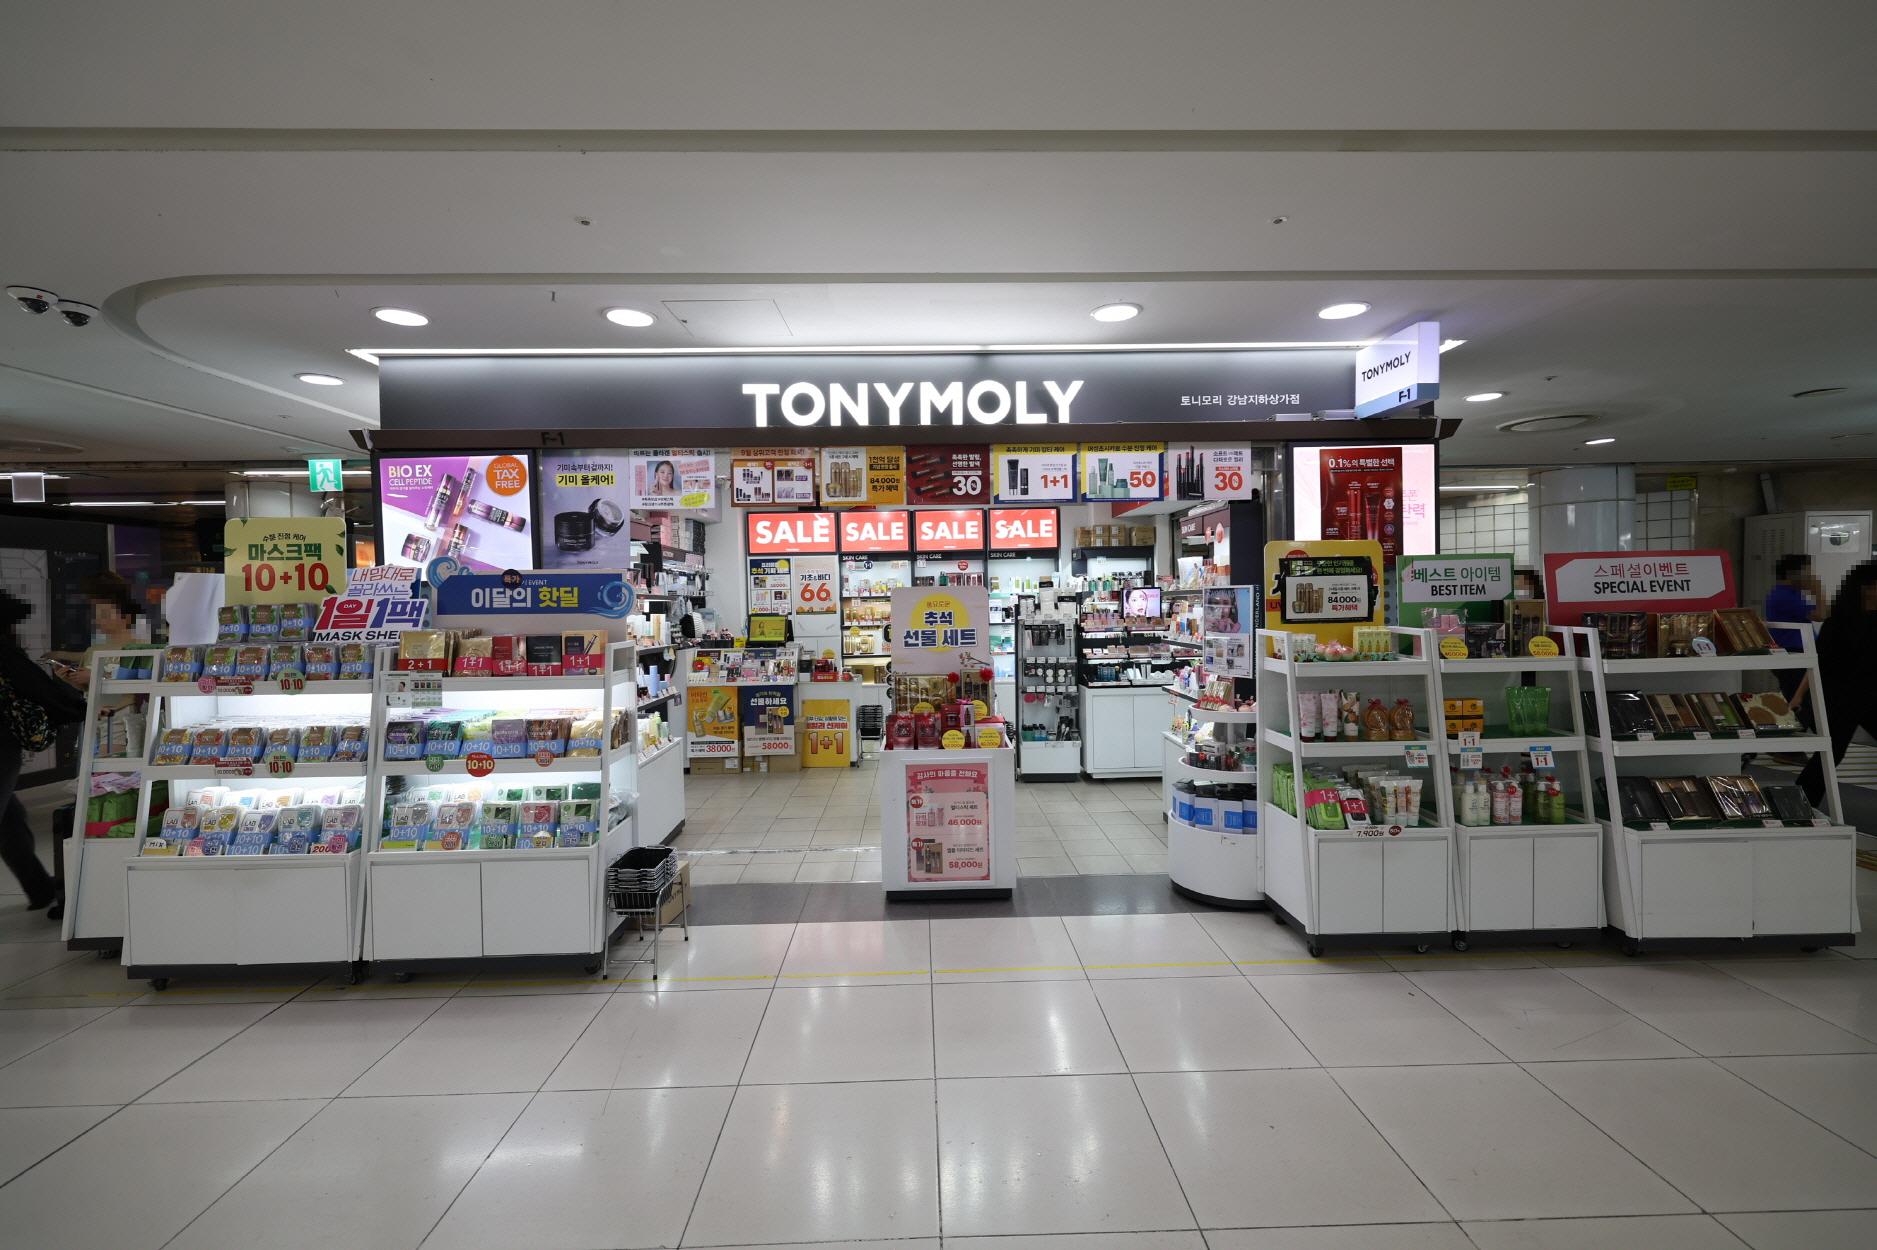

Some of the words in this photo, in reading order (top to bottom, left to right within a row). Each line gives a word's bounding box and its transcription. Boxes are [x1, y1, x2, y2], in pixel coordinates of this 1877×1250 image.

[1361, 351, 1411, 382] TONYMOLY
[1180, 394, 1222, 406] 토니모리
[1227, 392, 1300, 405] 강남지하상가점
[1398, 388, 1411, 402] F-1
[742, 380, 1085, 427] TONYMOLY
[541, 432, 565, 446] F-1
[388, 465, 413, 479] BIO
[415, 464, 433, 477] EX
[493, 469, 519, 479] TAX
[406, 478, 433, 486] PEPTIDE
[495, 480, 521, 488] FREE
[558, 475, 578, 486] 기미
[581, 475, 614, 486] 올케어!
[1040, 474, 1069, 489] 1+1
[755, 520, 830, 545] SALE
[846, 522, 904, 542] SALE
[920, 520, 979, 541] SALE
[995, 519, 1053, 538] SALE
[262, 533, 276, 543] 수분
[248, 543, 322, 561] 마스크팩
[241, 562, 329, 592] 10+10
[504, 575, 521, 584] 특가
[1413, 568, 1457, 582] 베스트
[1460, 567, 1501, 582] 아이템
[1431, 584, 1458, 597] BEST
[1459, 583, 1486, 596] ITEM
[1593, 580, 1648, 595] SPECIAL
[1650, 579, 1691, 592] EVENT
[471, 587, 531, 609] 이달의
[538, 587, 579, 608] 핫딜
[924, 611, 953, 626] 추석
[252, 624, 278, 633] 10+10
[316, 631, 363, 641] MASK
[365, 631, 401, 641] SHE
[903, 629, 937, 648] 선물
[942, 629, 977, 647] 세트
[462, 657, 483, 668] 1+1
[570, 655, 591, 666] 1+1
[166, 664, 191, 672] 10+10
[533, 665, 553, 676] 1+1
[427, 742, 454, 752] 10+10
[463, 742, 490, 752] 10+10
[529, 742, 557, 751] 10+10
[808, 731, 844, 754] 1+1
[389, 745, 417, 755] 10+10
[494, 745, 520, 755] 10+10
[467, 760, 493, 769] 10+10
[1343, 801, 1365, 811] 1+1
[161, 829, 189, 838] 10+10
[391, 828, 418, 838] 10+10
[483, 825, 508, 833] 10+10
[523, 824, 549, 832] 10+10
[235, 834, 264, 843] 10+10
[231, 845, 259, 855] 10+10
